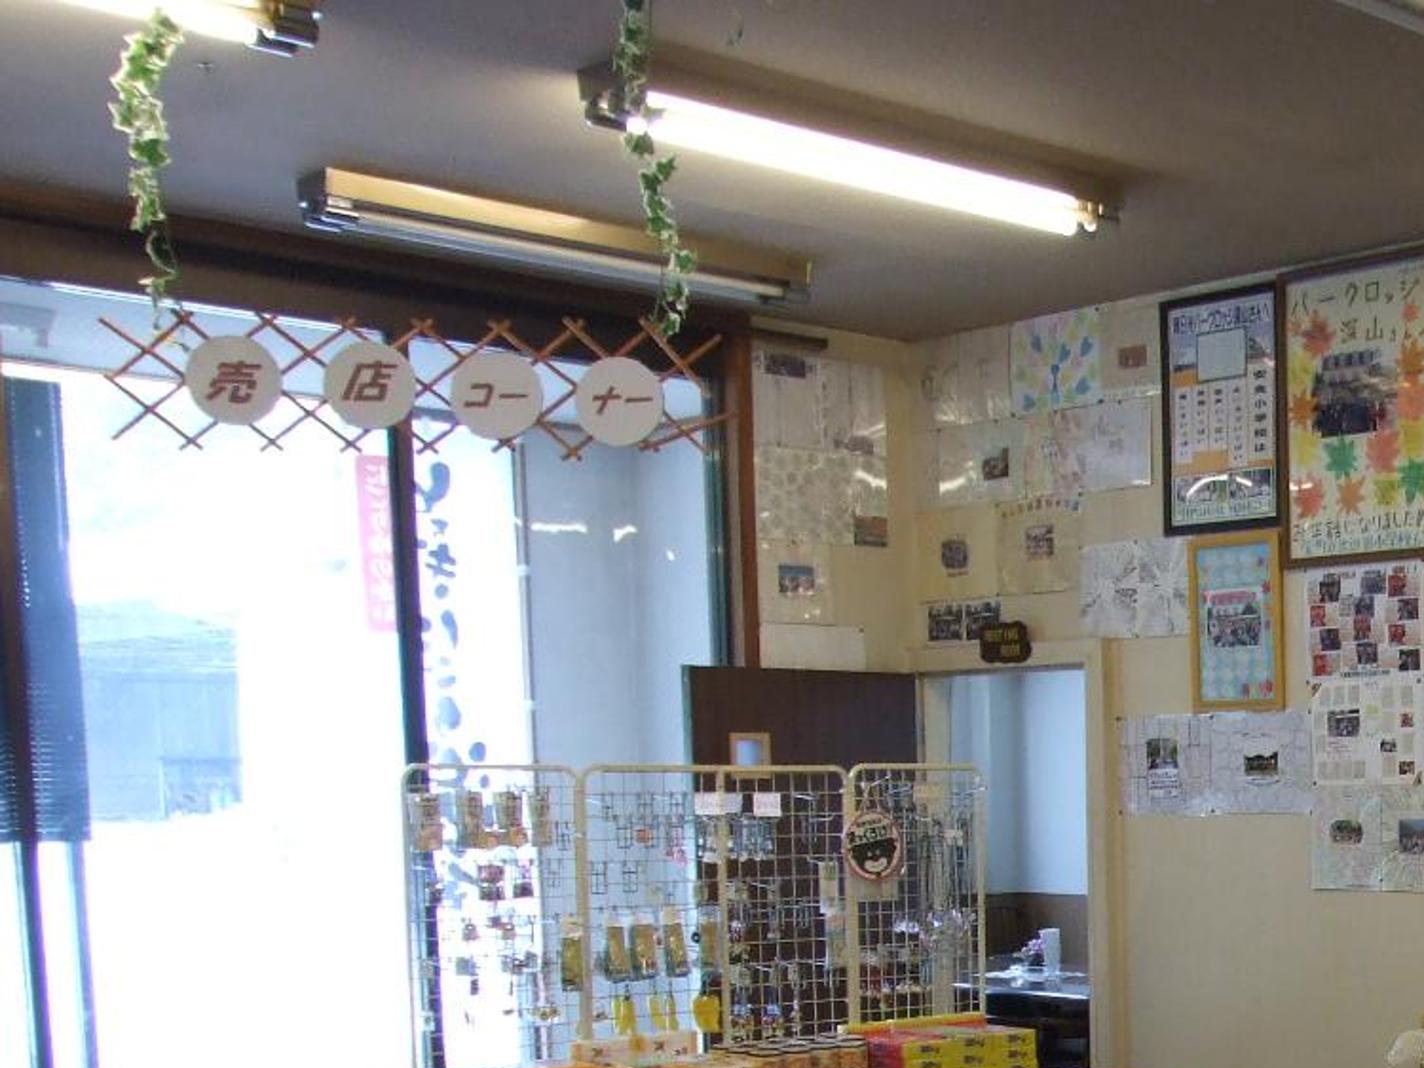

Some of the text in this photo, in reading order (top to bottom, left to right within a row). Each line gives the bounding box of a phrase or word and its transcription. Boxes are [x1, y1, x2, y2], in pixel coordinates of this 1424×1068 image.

[1290, 276, 1420, 316] パークロッジ
[205, 359, 656, 415] 売店コーナー
